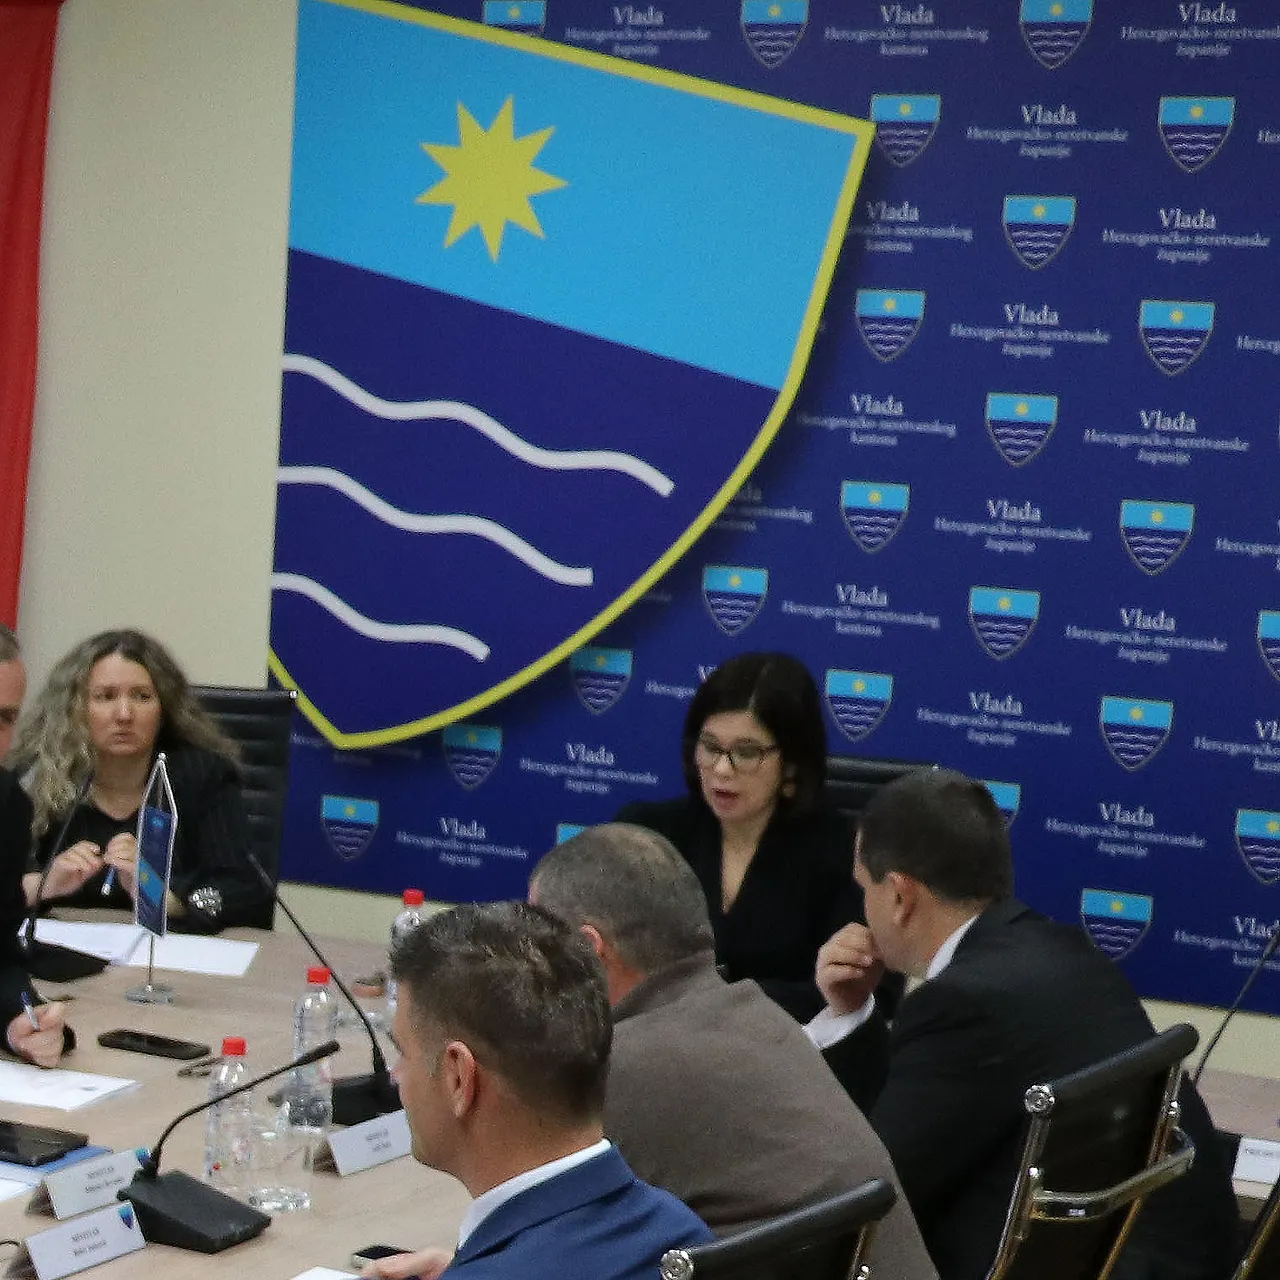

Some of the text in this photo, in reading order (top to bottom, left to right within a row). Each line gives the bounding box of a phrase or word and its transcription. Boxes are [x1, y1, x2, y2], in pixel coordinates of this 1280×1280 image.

[613, 5, 665, 25] Vlada
[880, 4, 934, 25] Vlada
[1178, 2, 1236, 23] Vlada
[1021, 104, 1077, 125] Vlada
[867, 201, 920, 222] Vlada
[1160, 207, 1217, 230] Vlada
[1004, 304, 1059, 324] Vlada
[851, 394, 903, 415] Vlada
[1140, 409, 1197, 432] Vlada
[987, 499, 1042, 521] Vlada
[836, 583, 888, 606] Vlada
[1120, 607, 1176, 630] Vlada
[970, 691, 1023, 715] Vlada
[565, 743, 616, 765] Vlada
[1099, 802, 1155, 826] Vlada
[440, 817, 486, 839] Vlada
